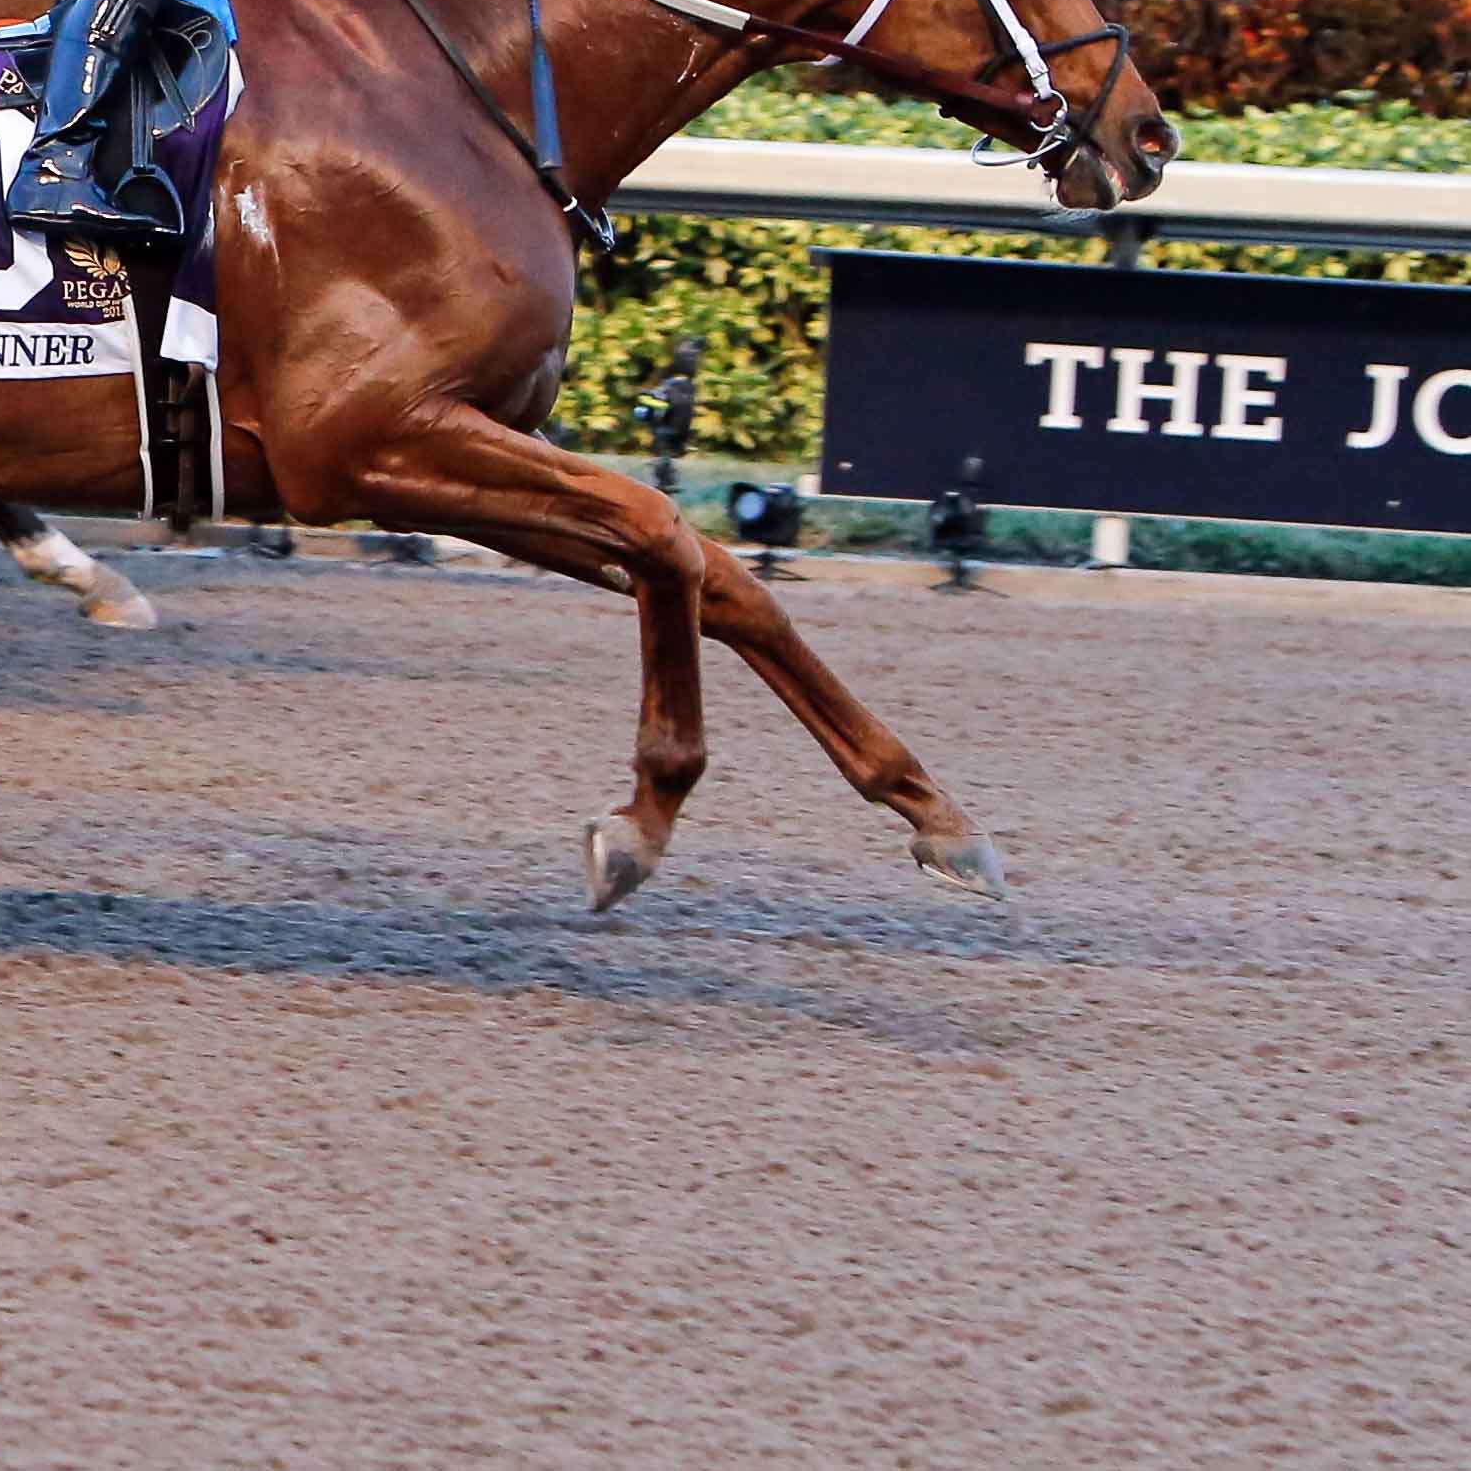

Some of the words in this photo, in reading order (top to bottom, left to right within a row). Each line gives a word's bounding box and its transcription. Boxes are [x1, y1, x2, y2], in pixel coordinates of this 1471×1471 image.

[66, 300, 95, 309] WORLD
[102, 305, 121, 318] 201
[1025, 342, 1288, 442] THE
[1345, 362, 1471, 456] JO
